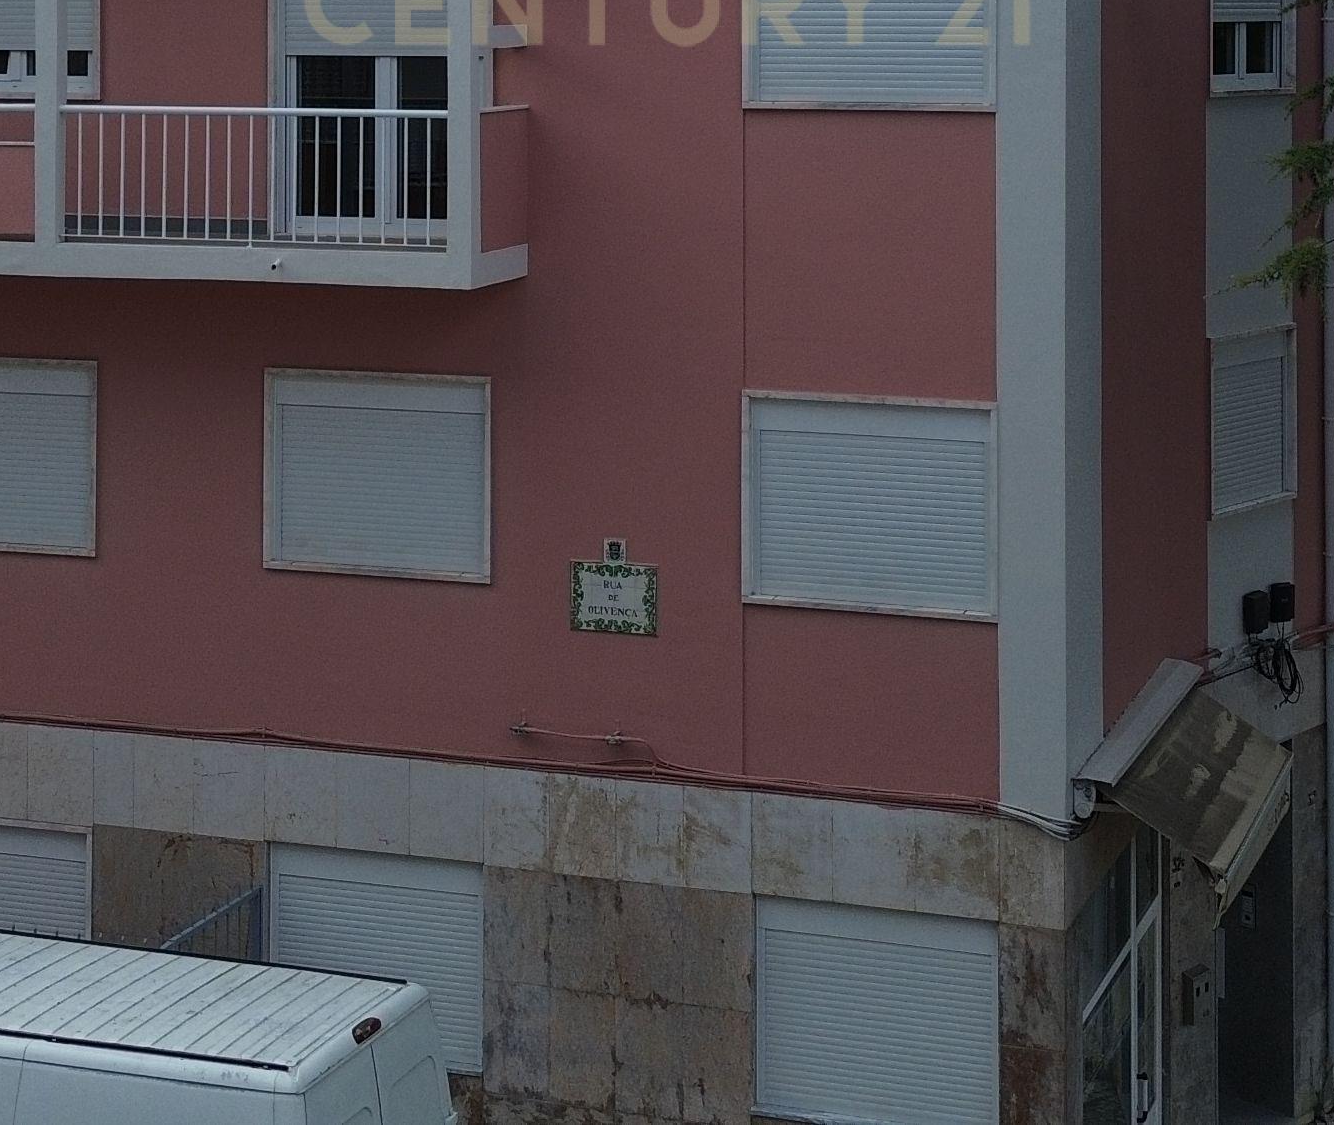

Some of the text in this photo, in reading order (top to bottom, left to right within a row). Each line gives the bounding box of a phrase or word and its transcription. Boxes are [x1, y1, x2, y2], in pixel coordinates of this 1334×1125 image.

[603, 579, 623, 590] RUA
[608, 594, 620, 602] DE
[588, 605, 638, 619] OLIVENÇA
